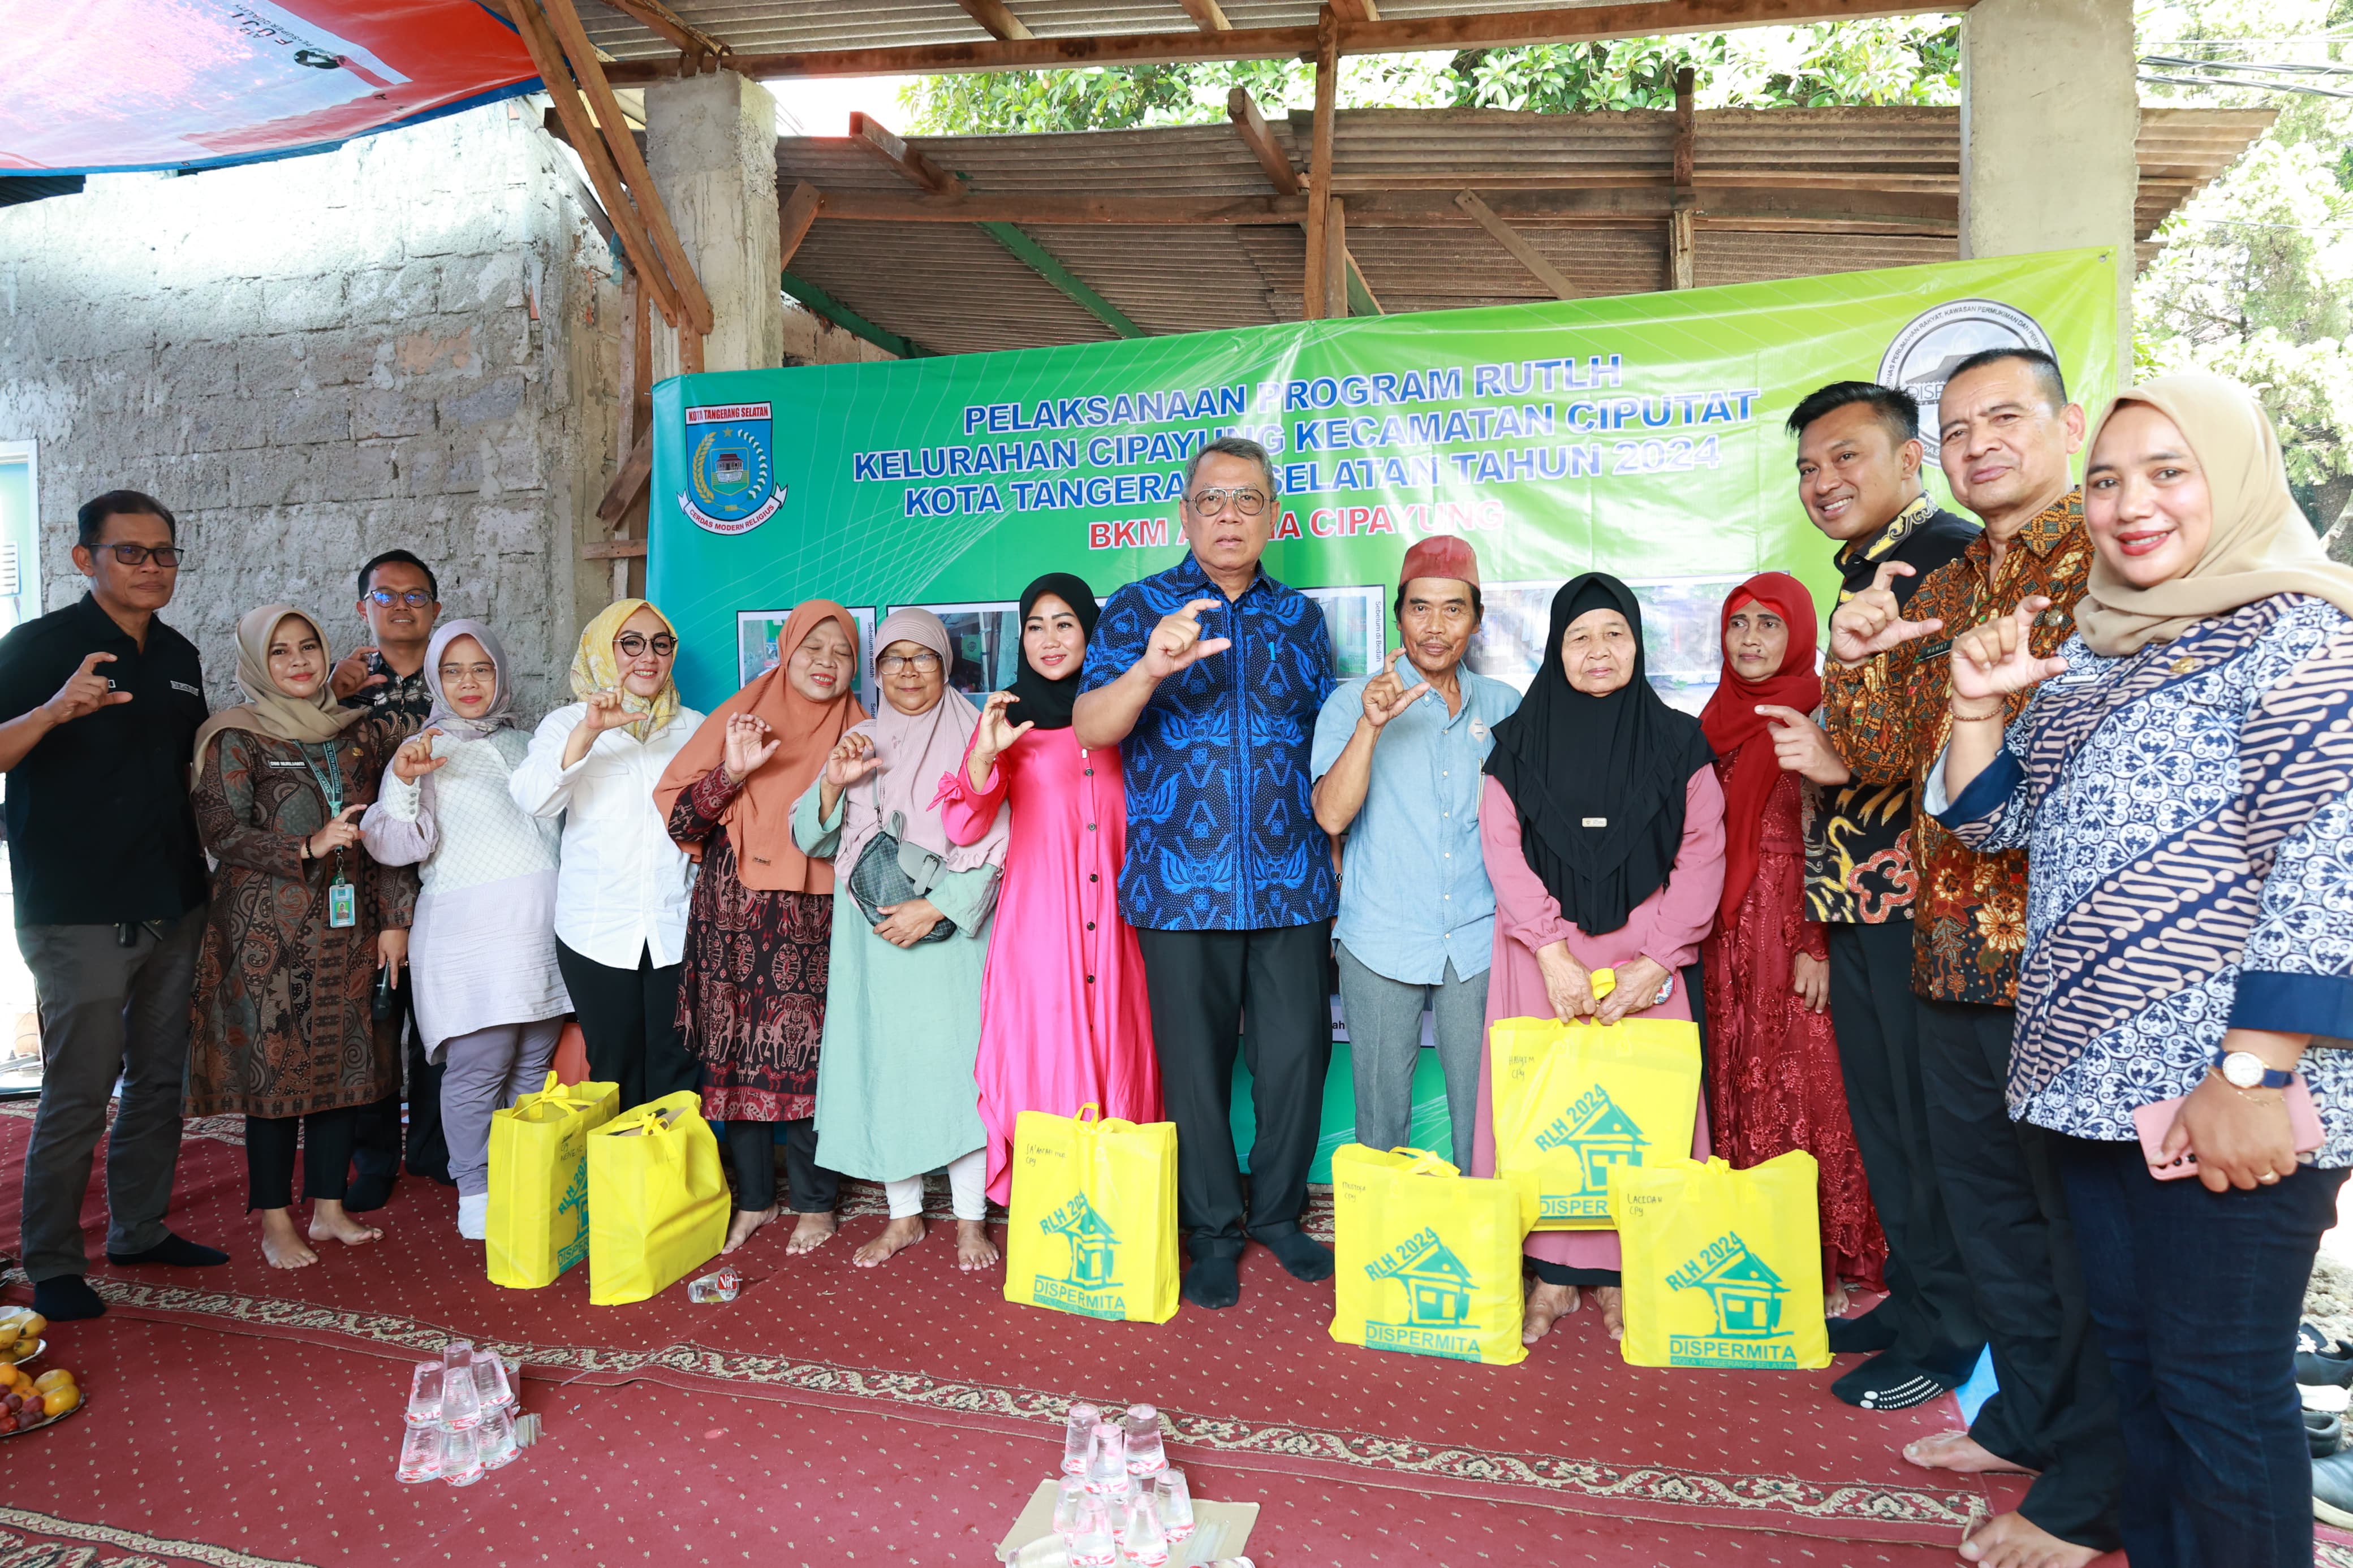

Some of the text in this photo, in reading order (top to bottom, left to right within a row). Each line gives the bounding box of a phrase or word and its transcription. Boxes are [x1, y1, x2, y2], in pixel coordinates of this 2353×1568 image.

[1892, 328, 1920, 362] PERUMAHAN
[1945, 305, 1977, 316] KAWASAN
[1977, 306, 2018, 323] PERMUKIMAN
[2017, 319, 2031, 332] DAN
[964, 353, 1622, 435] PELAKSANAAN PROGRAM RUTLH
[689, 407, 768, 421] KOTA TANGERANG SELATAN
[853, 438, 1078, 482] KELURAHAN
[1295, 403, 1554, 453] KECAMATAN
[1566, 387, 1761, 434] CIPUTAT
[905, 483, 1004, 517] KOTA
[1450, 443, 1601, 485] TAHUN
[1612, 434, 1722, 475] 2024
[689, 504, 774, 532] CERDAS MODERN RELIGIUS
[1089, 517, 1168, 550] BKM
[1310, 501, 1503, 535] CIPAYUNG
[331, 763, 341, 793] PEMERINTAH
[1534, 1083, 1608, 1152] RLH 2024
[574, 1155, 587, 1185] 202
[1040, 1207, 1068, 1236] RLH
[1540, 1199, 1608, 1214] DISPER
[558, 1236, 589, 1266] DISPER
[1364, 1226, 1439, 1281] RLH 2024
[1665, 1230, 1745, 1291] RLH 2024
[1034, 1278, 1126, 1310] DISPERMITA
[1365, 1324, 1481, 1353] DISPERMITA
[1670, 1340, 1796, 1360] DISPERMITA
[1699, 1358, 1753, 1368] TANGERANG
